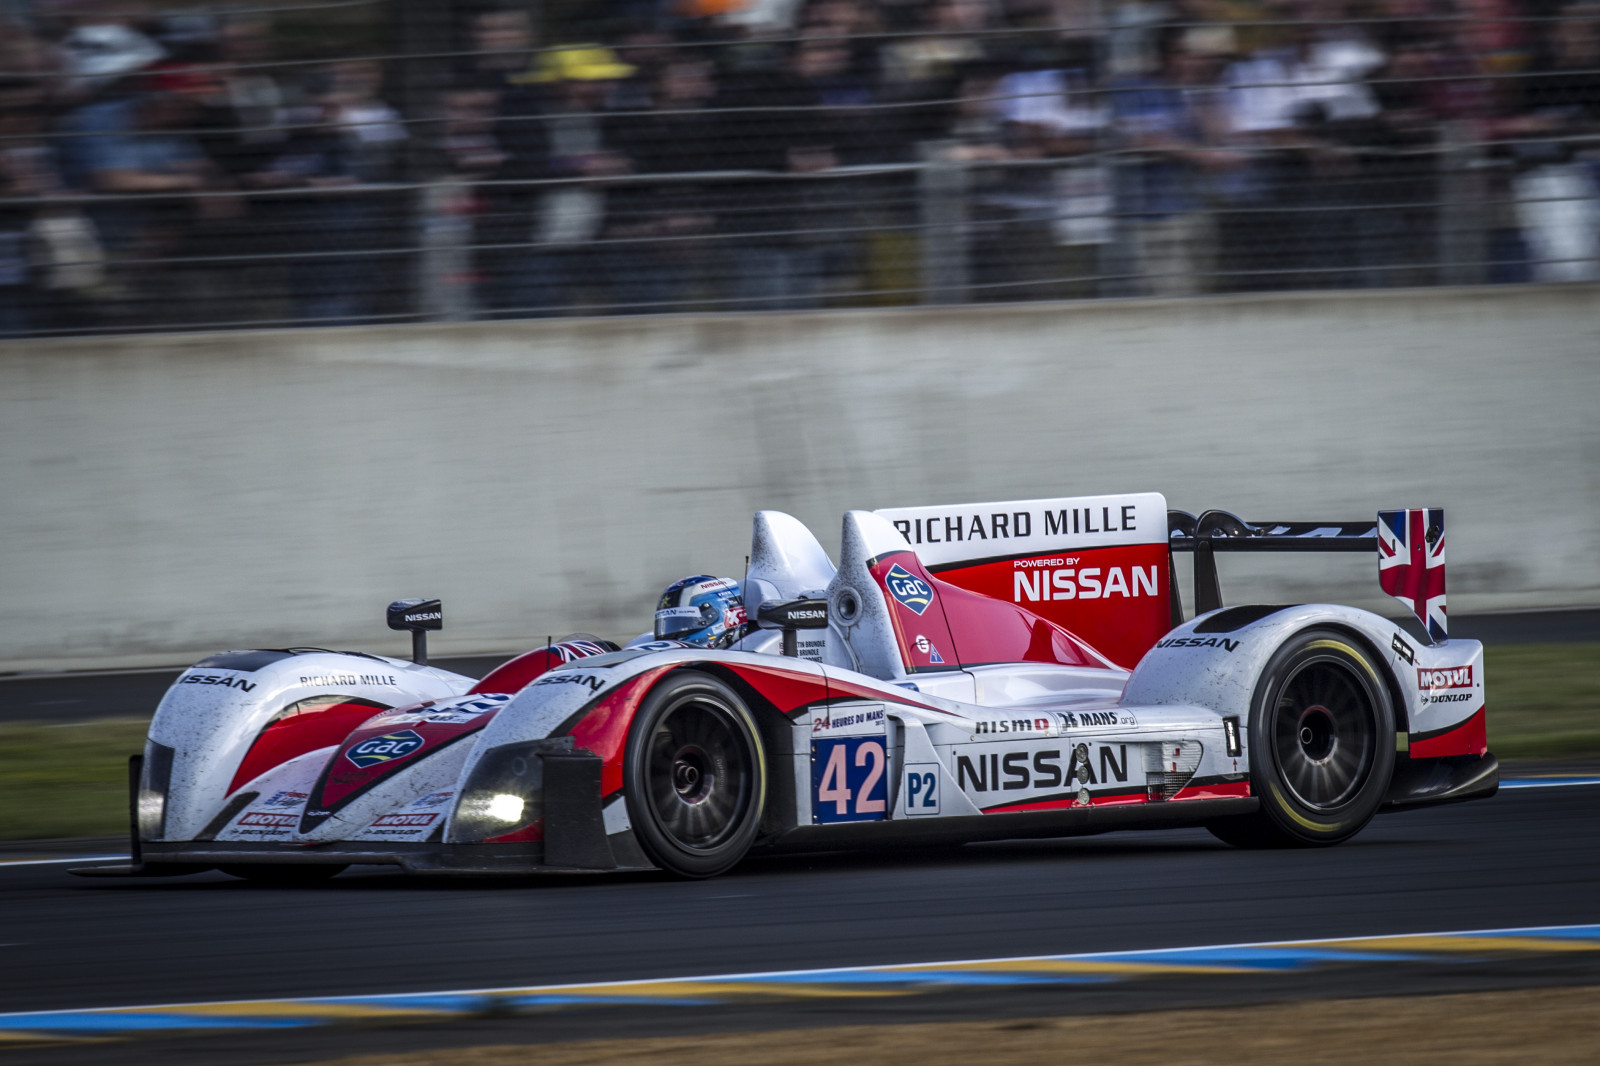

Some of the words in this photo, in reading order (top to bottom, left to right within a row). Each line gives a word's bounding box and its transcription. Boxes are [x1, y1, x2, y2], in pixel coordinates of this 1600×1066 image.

[894, 511, 1032, 545] RICHARD
[1044, 505, 1137, 536] MILLE
[1014, 558, 1064, 568] POWERED
[1066, 557, 1080, 566] BY
[1014, 565, 1159, 603] NISSAN
[405, 612, 442, 622] NISSAN
[787, 610, 826, 620] NISSAN
[1156, 637, 1240, 653] NISSAN
[179, 674, 257, 693] ISSAN
[300, 674, 357, 687] RICHARD
[360, 674, 397, 686] MILLE
[532, 674, 606, 692] SSAN
[1420, 668, 1472, 688] MOTUL
[1430, 693, 1473, 704] DUNLOP
[813, 716, 831, 732] 24
[831, 716, 855, 729] HEURES
[855, 713, 865, 724] DU
[866, 709, 885, 722] MANS
[1079, 711, 1119, 727] MANS
[957, 744, 1128, 793] NISSAN
[818, 741, 886, 815] 42
[907, 772, 937, 808] P2
[375, 814, 434, 825] MOTUL
